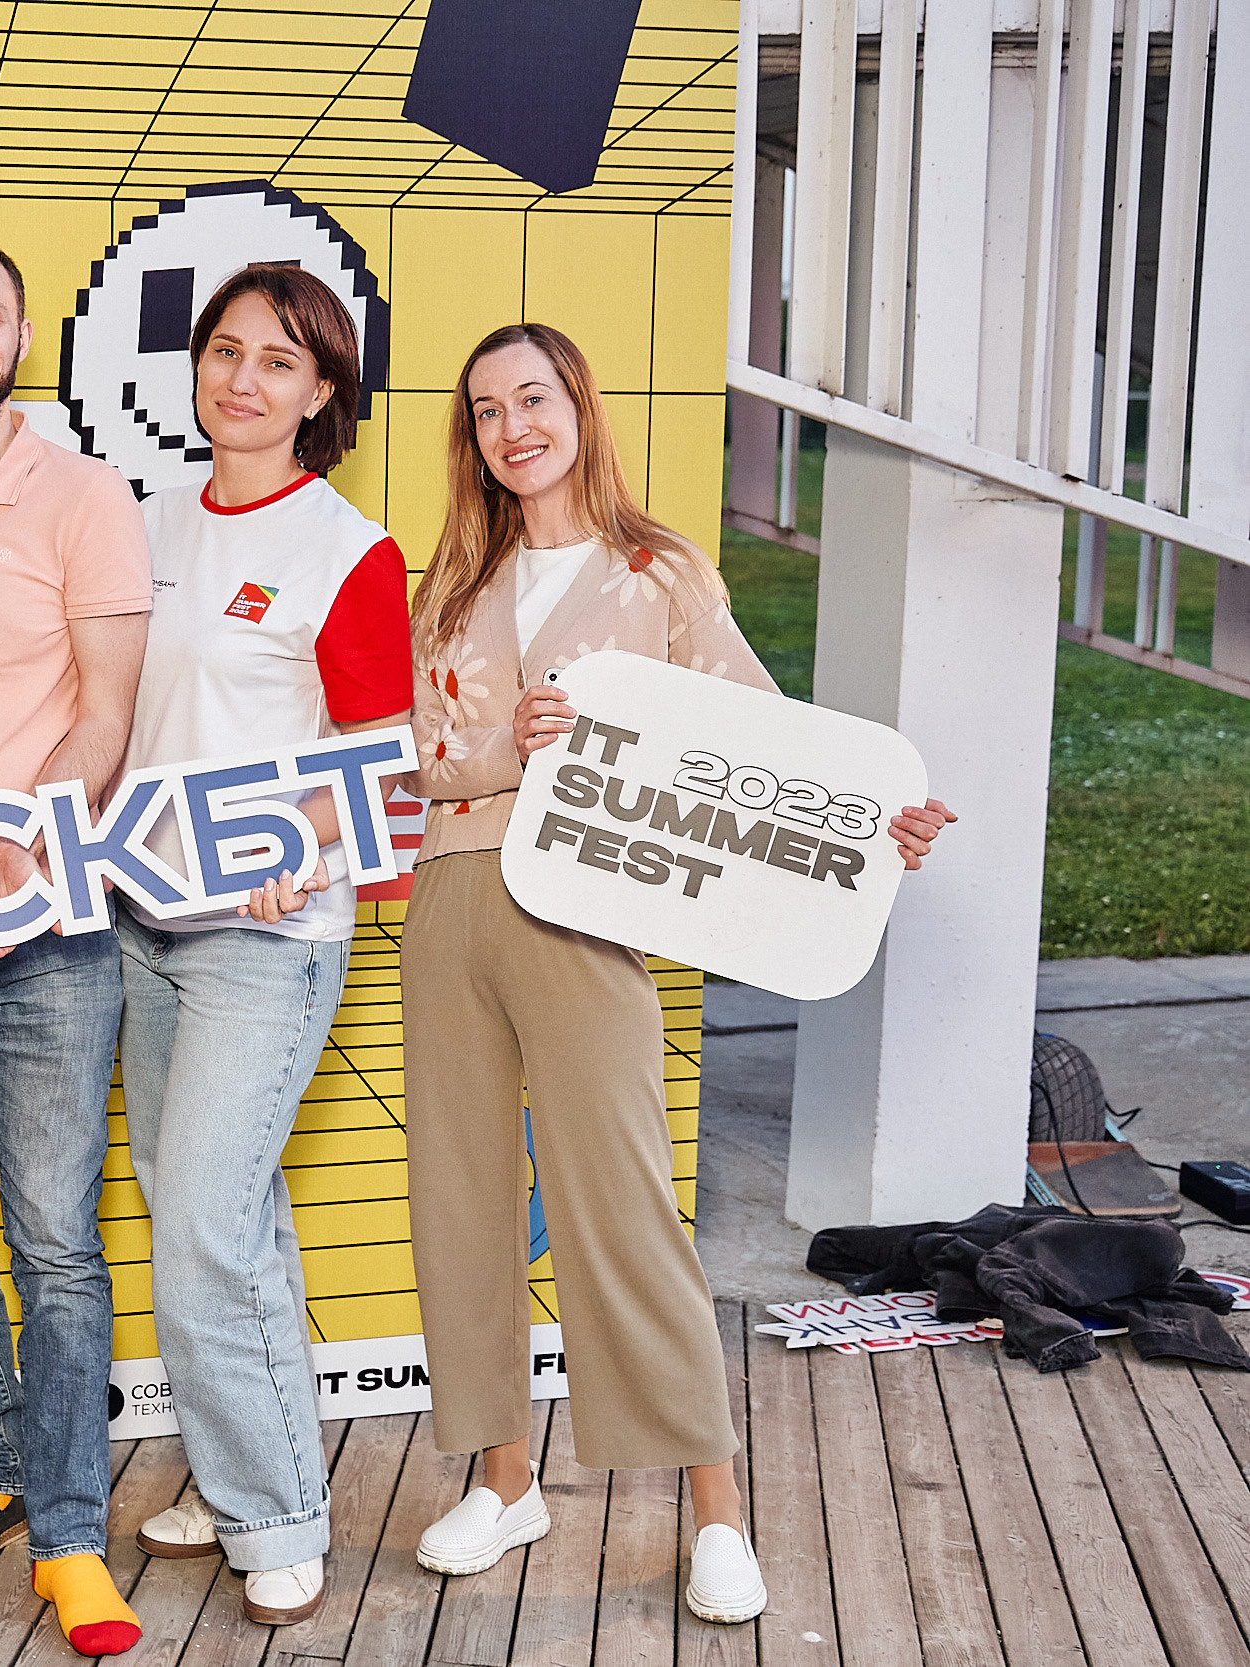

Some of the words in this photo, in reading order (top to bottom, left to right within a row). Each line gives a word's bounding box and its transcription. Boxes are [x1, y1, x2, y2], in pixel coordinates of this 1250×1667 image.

[567, 715, 640, 766] IT
[552, 764, 866, 892] SUMMER
[673, 750, 882, 840] 2023
[535, 811, 724, 899] FEST
